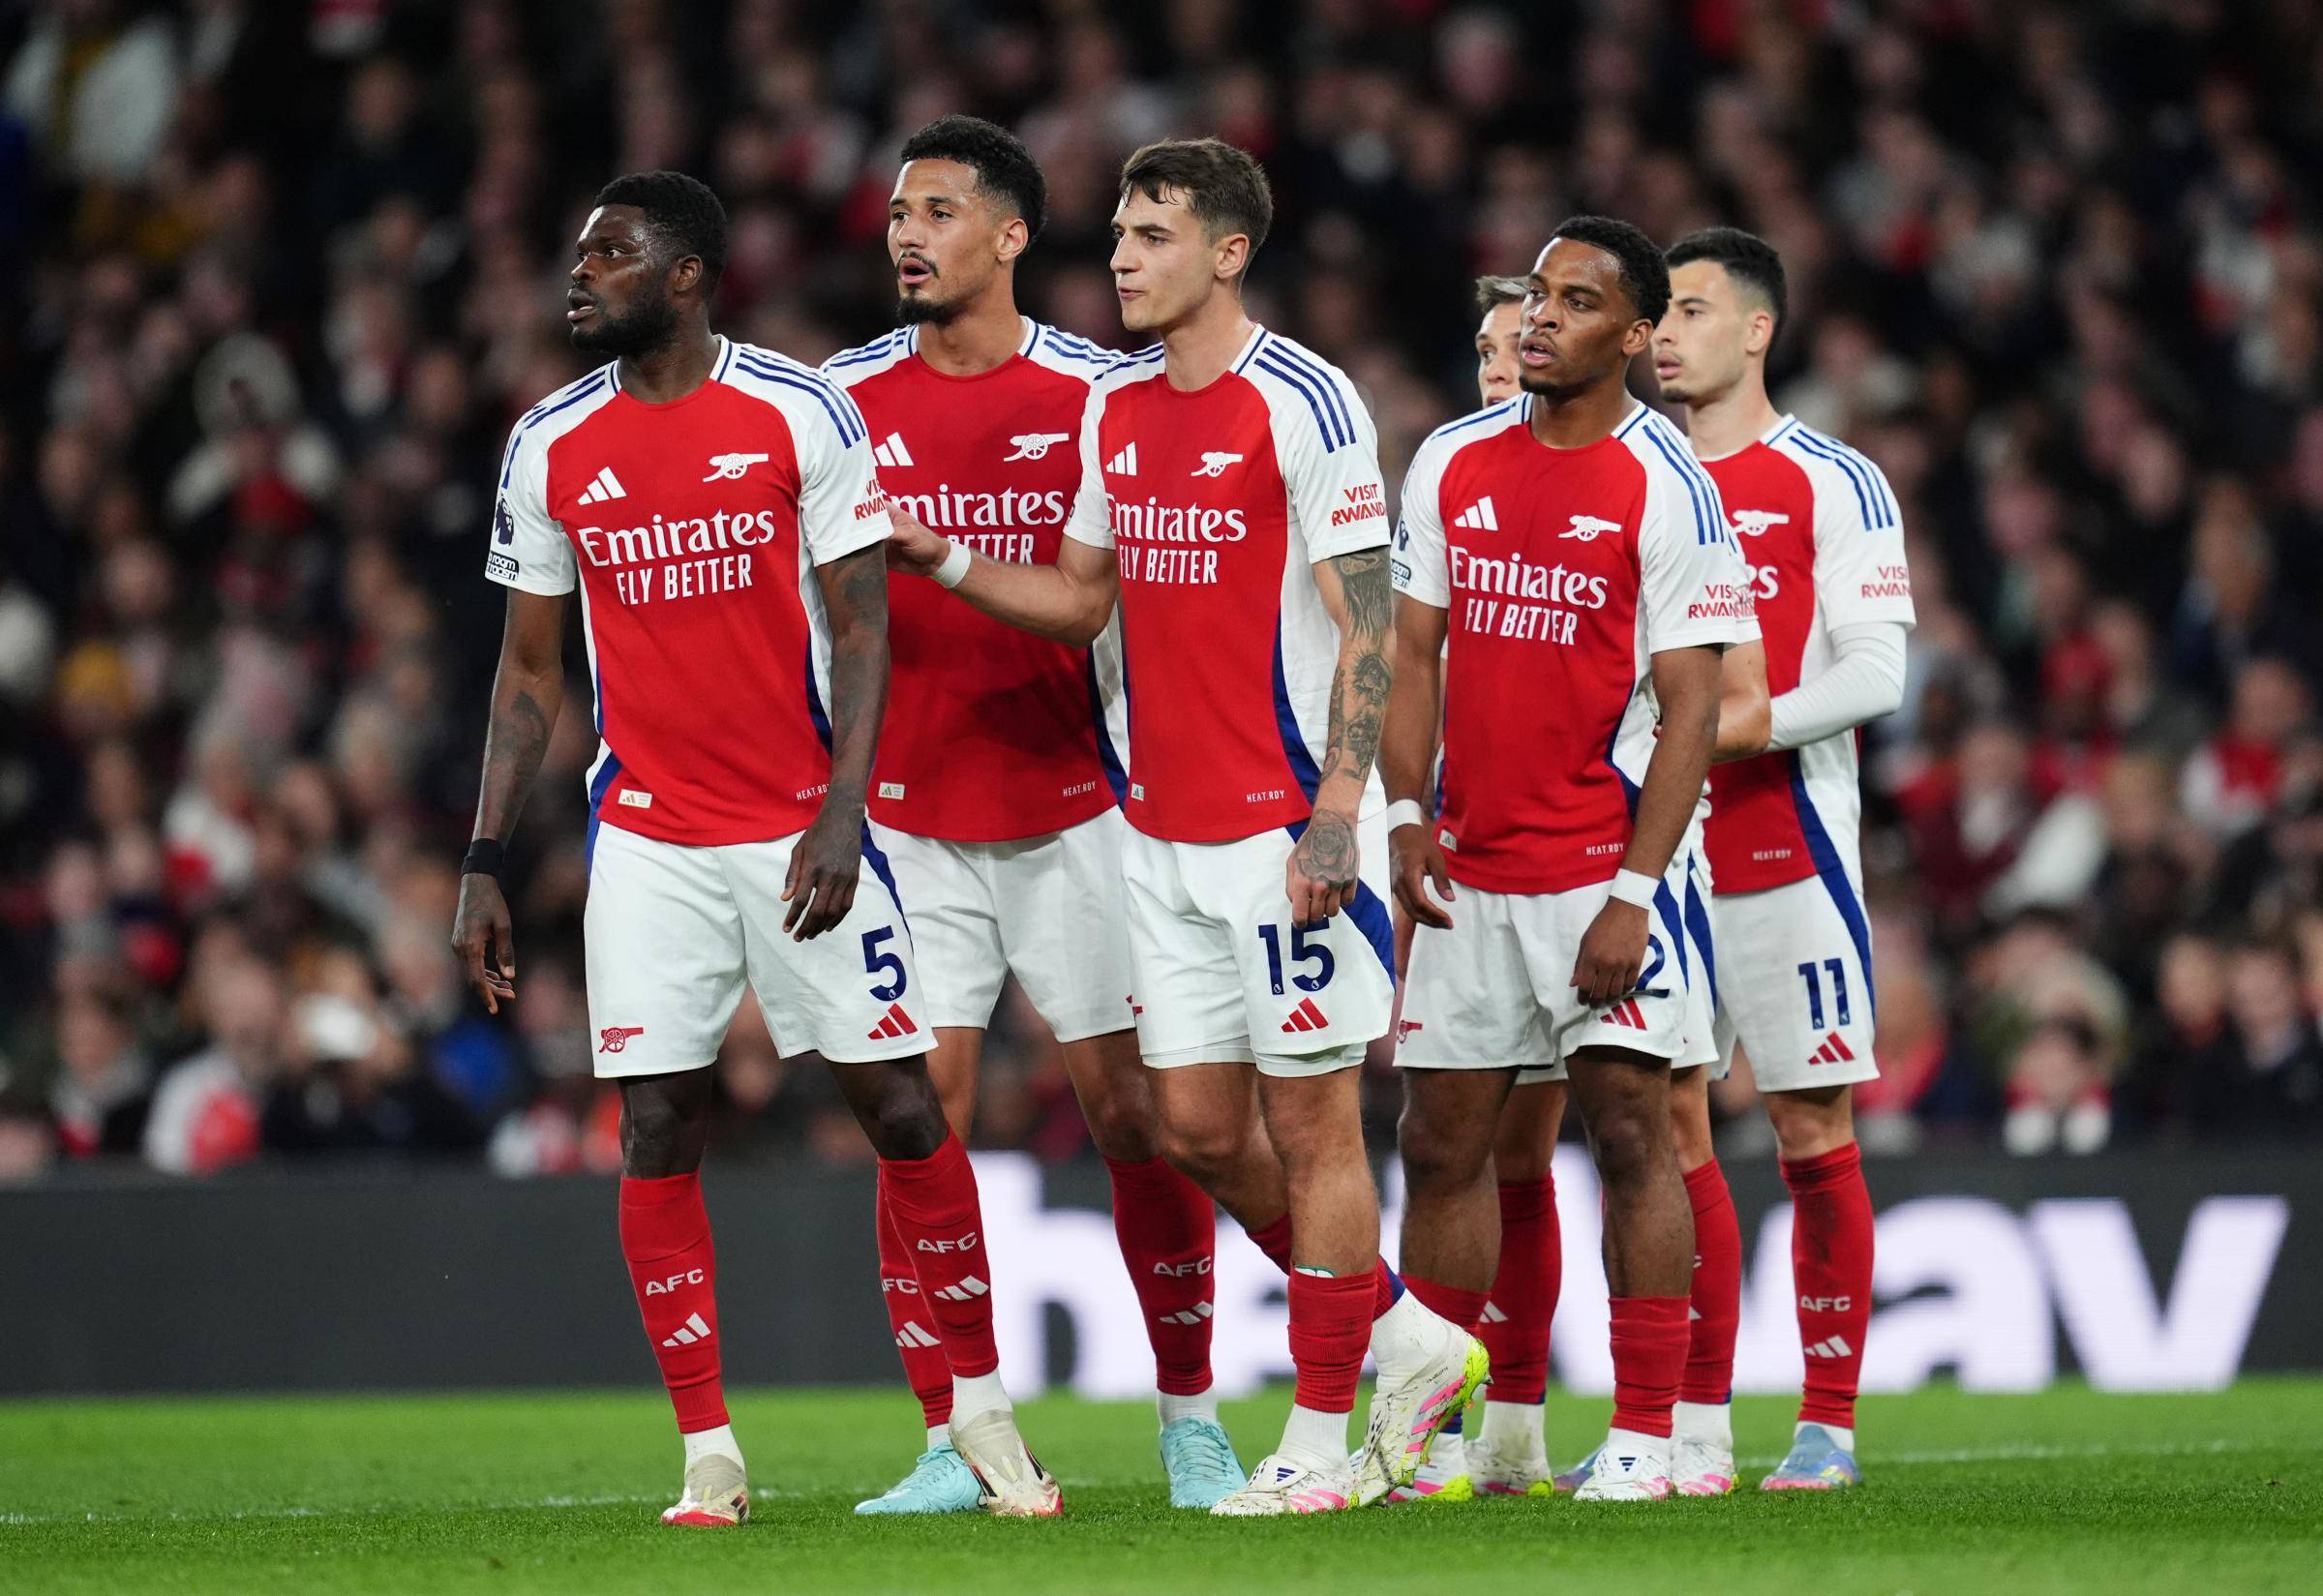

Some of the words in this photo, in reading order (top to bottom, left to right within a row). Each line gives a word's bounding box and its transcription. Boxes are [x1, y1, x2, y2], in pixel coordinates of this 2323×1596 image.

[880, 484, 1065, 527] mirates
[1343, 483, 1378, 503] VISIT
[1331, 501, 1387, 527] RWAND
[577, 508, 775, 567] Emirates
[616, 566, 653, 605] FLY
[664, 554, 753, 600] BETTER
[1119, 544, 1140, 581] FLY
[1145, 549, 1218, 585] BETTER
[1449, 545, 1609, 610] Emirates
[1861, 583, 1912, 599] RWAN
[1464, 598, 1499, 635] FLY
[1499, 603, 1578, 646] BETTER
[796, 783, 830, 800] HEAT.RD
[861, 925, 907, 1003] 5
[1258, 916, 1336, 996] 15
[1797, 958, 1851, 1029] 11
[917, 1231, 978, 1253] AFC
[646, 1268, 705, 1298] AFC
[1153, 1255, 1212, 1278] AFC
[881, 1278, 919, 1295] FC
[1800, 1295, 1852, 1312] AFC
